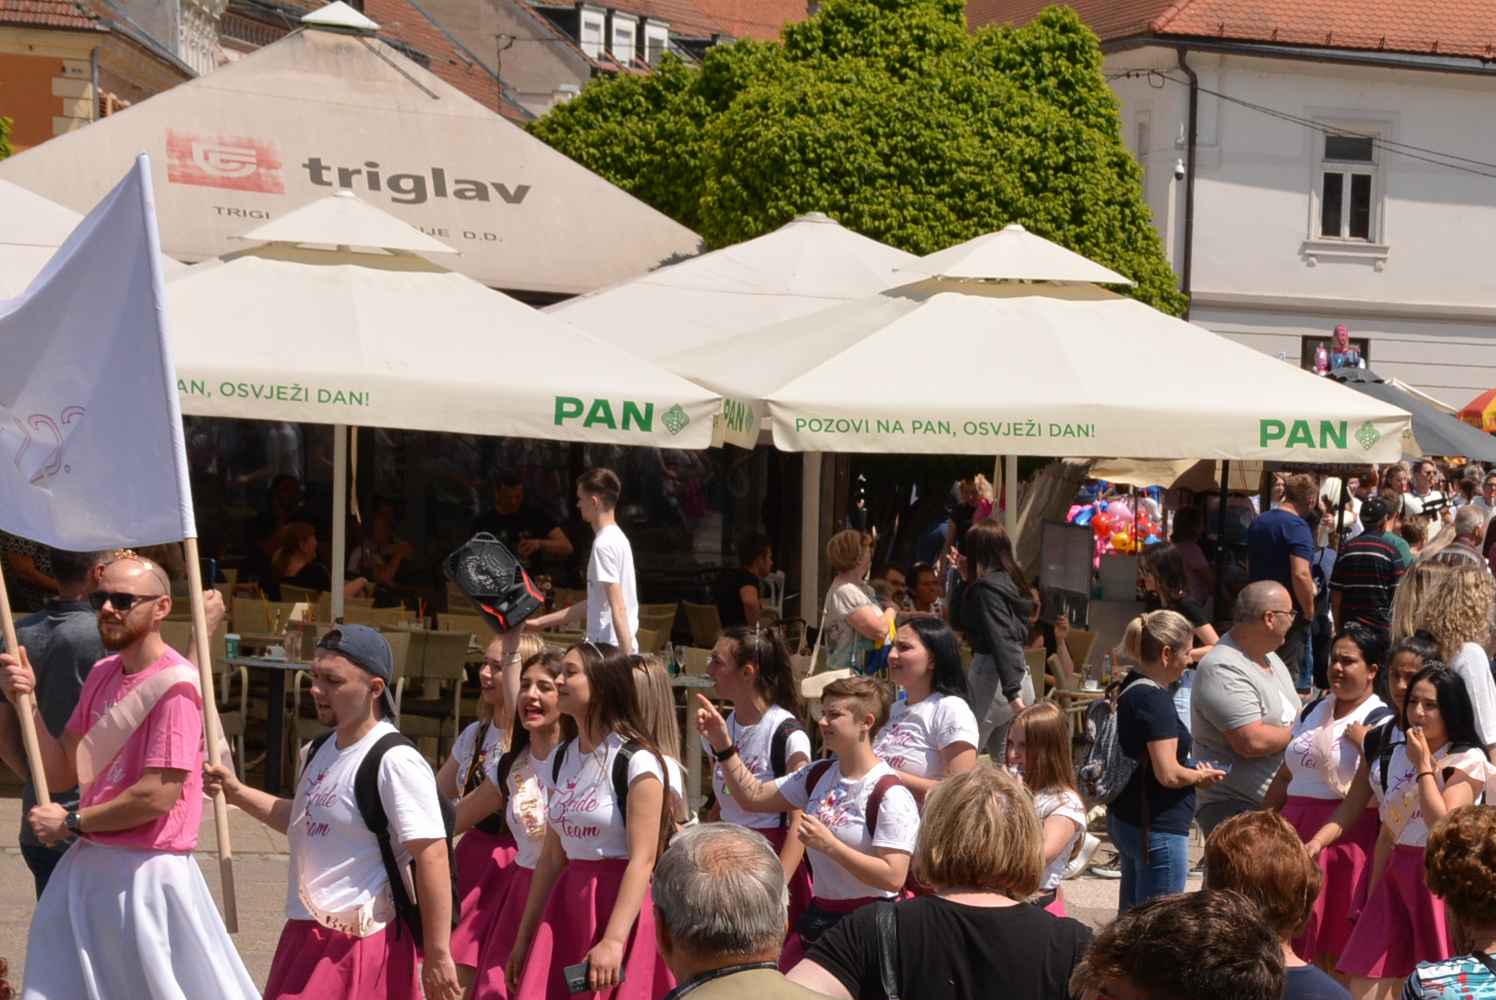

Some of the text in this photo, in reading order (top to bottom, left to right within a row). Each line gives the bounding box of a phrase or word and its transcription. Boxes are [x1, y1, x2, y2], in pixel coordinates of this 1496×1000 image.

[302, 158, 532, 205] triglav
[219, 382, 309, 402] OSVJEŽI
[317, 388, 370, 407] DAN!
[554, 395, 654, 432] PAN
[795, 417, 1096, 438] POZOVI NA PAN, OSVJEŽI DAN!
[1259, 419, 1348, 449] PAN
